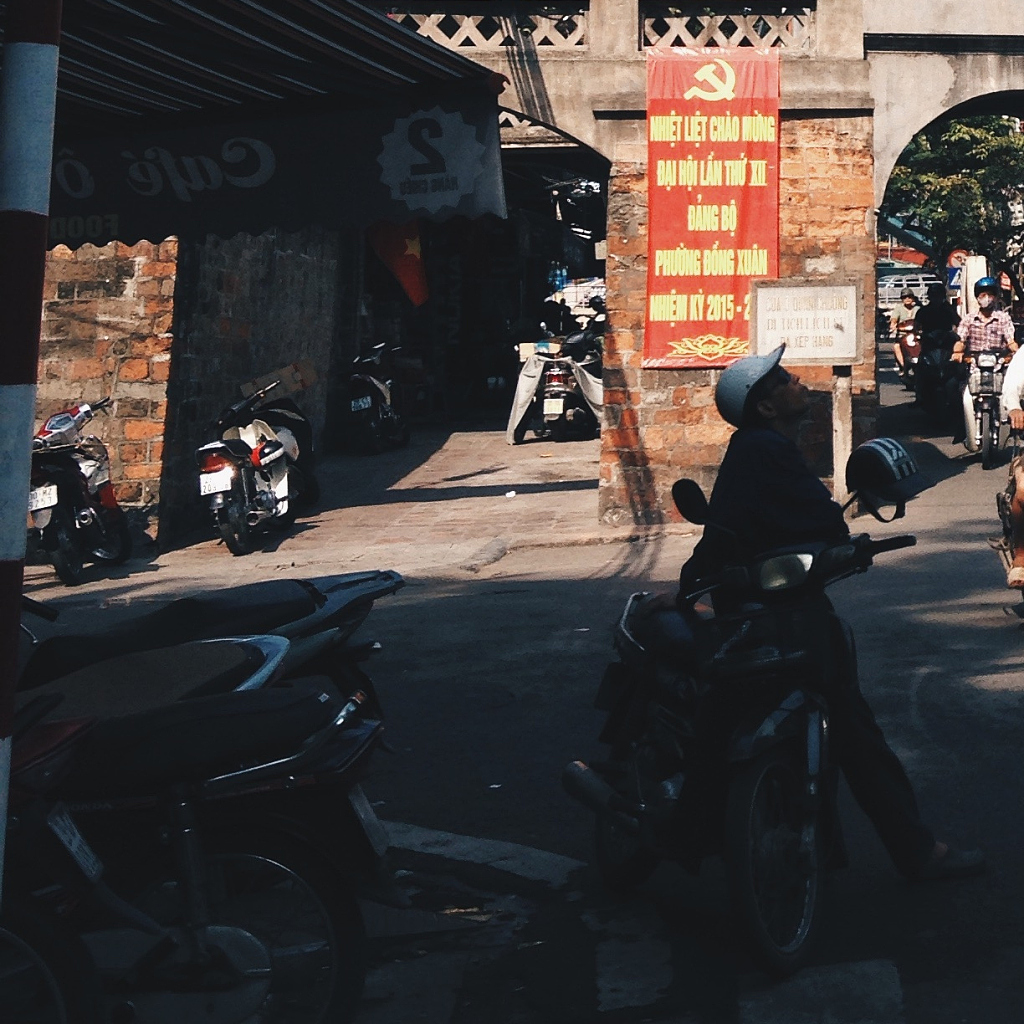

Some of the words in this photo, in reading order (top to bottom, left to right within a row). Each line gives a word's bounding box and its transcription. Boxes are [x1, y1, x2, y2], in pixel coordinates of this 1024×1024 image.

[650, 110, 683, 148] NHIỆT
[684, 110, 708, 148] LIỆT
[710, 110, 740, 142] CHÀO
[742, 110, 775, 142] MỪNG
[657, 160, 677, 191] ĐẠI
[678, 154, 698, 191] HỘI
[724, 152, 748, 186] THỨ
[687, 194, 719, 231] ĐẢNG
[720, 199, 737, 237] BỘ
[655, 242, 702, 276] PHƯỜNG
[736, 243, 768, 276] XUÂN
[650, 289, 688, 327] NHIỆM
[689, 288, 705, 321] KỲ
[706, 294, 734, 321] 2015
